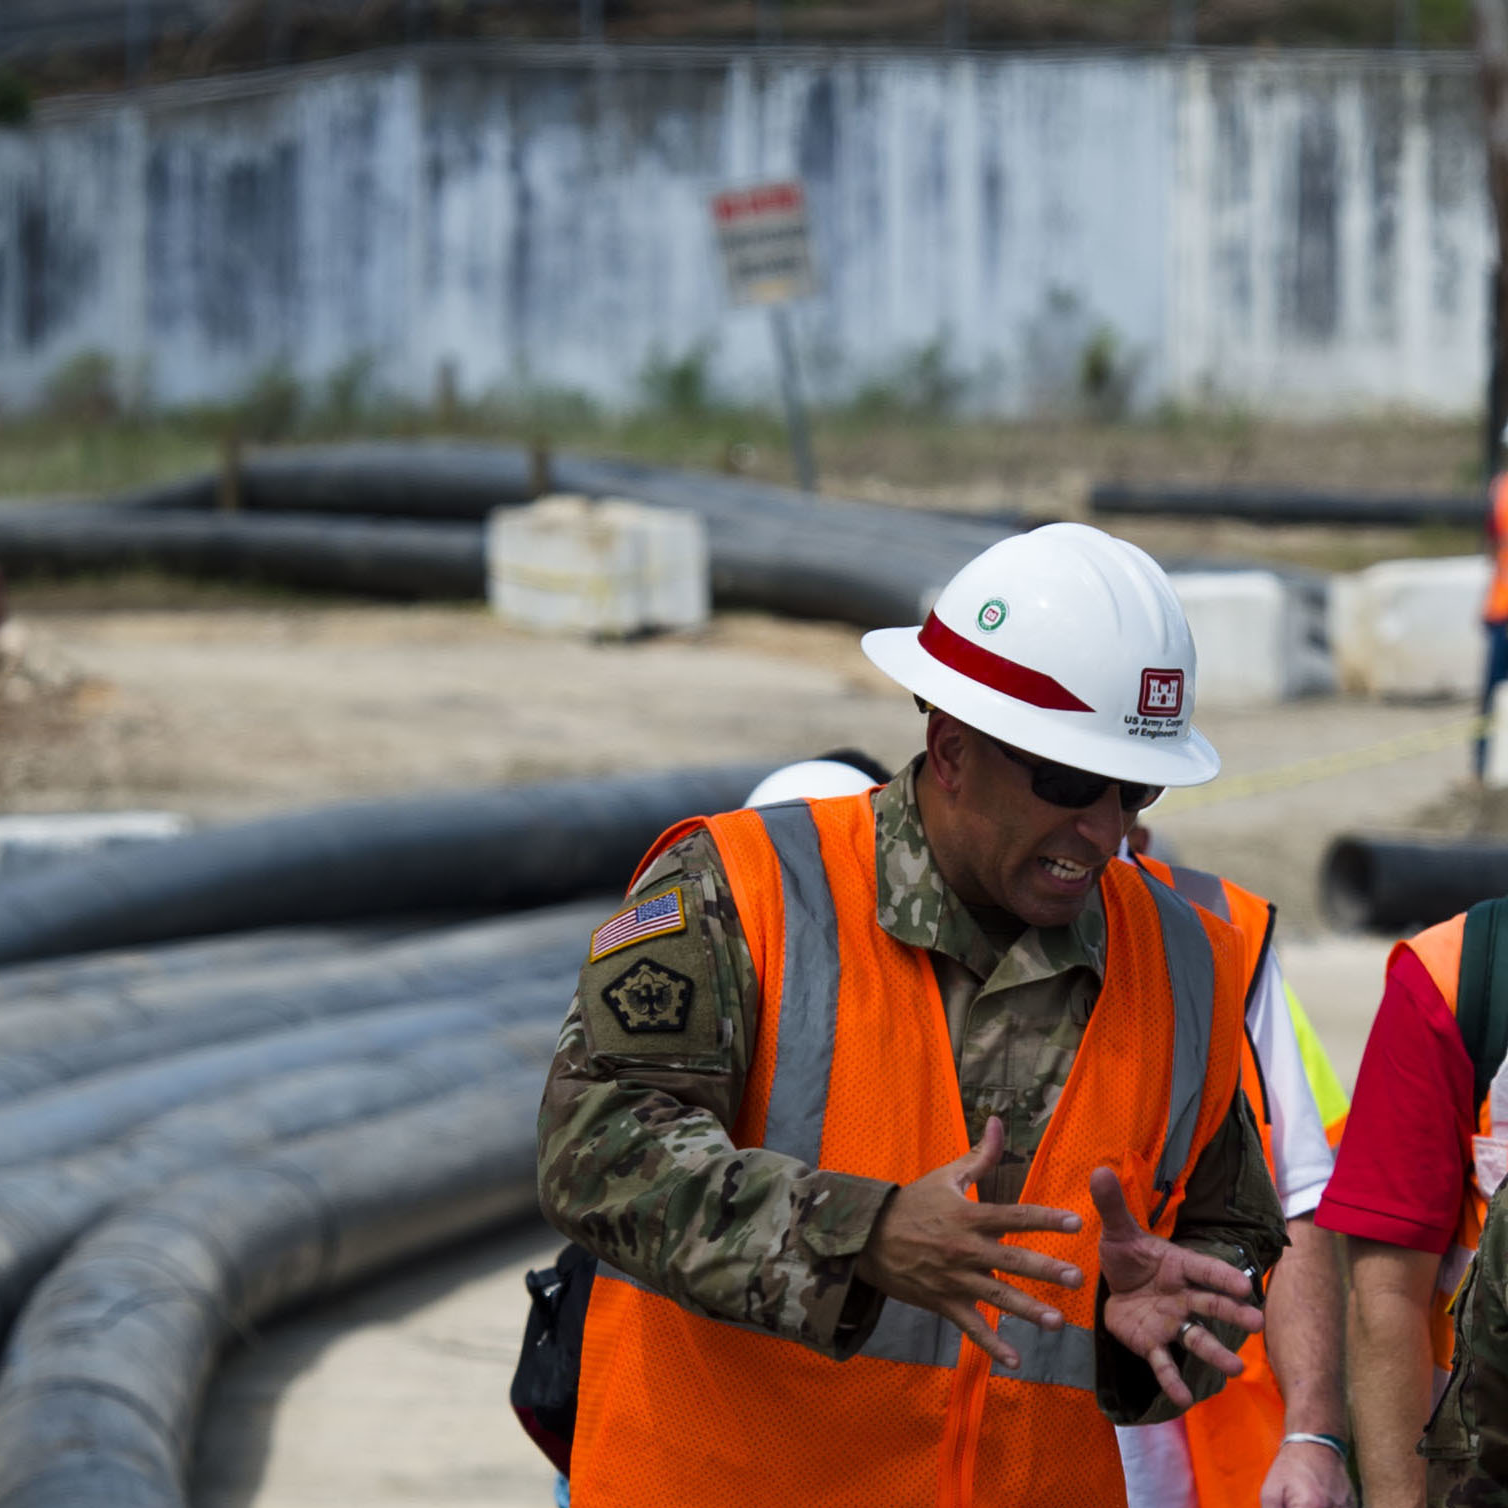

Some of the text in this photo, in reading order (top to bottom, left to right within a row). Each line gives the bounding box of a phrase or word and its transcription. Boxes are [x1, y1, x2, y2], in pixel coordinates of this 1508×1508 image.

[1124, 714, 1139, 725] US
[1141, 717, 1164, 730] Army
[1128, 727, 1178, 739] of Engineers
